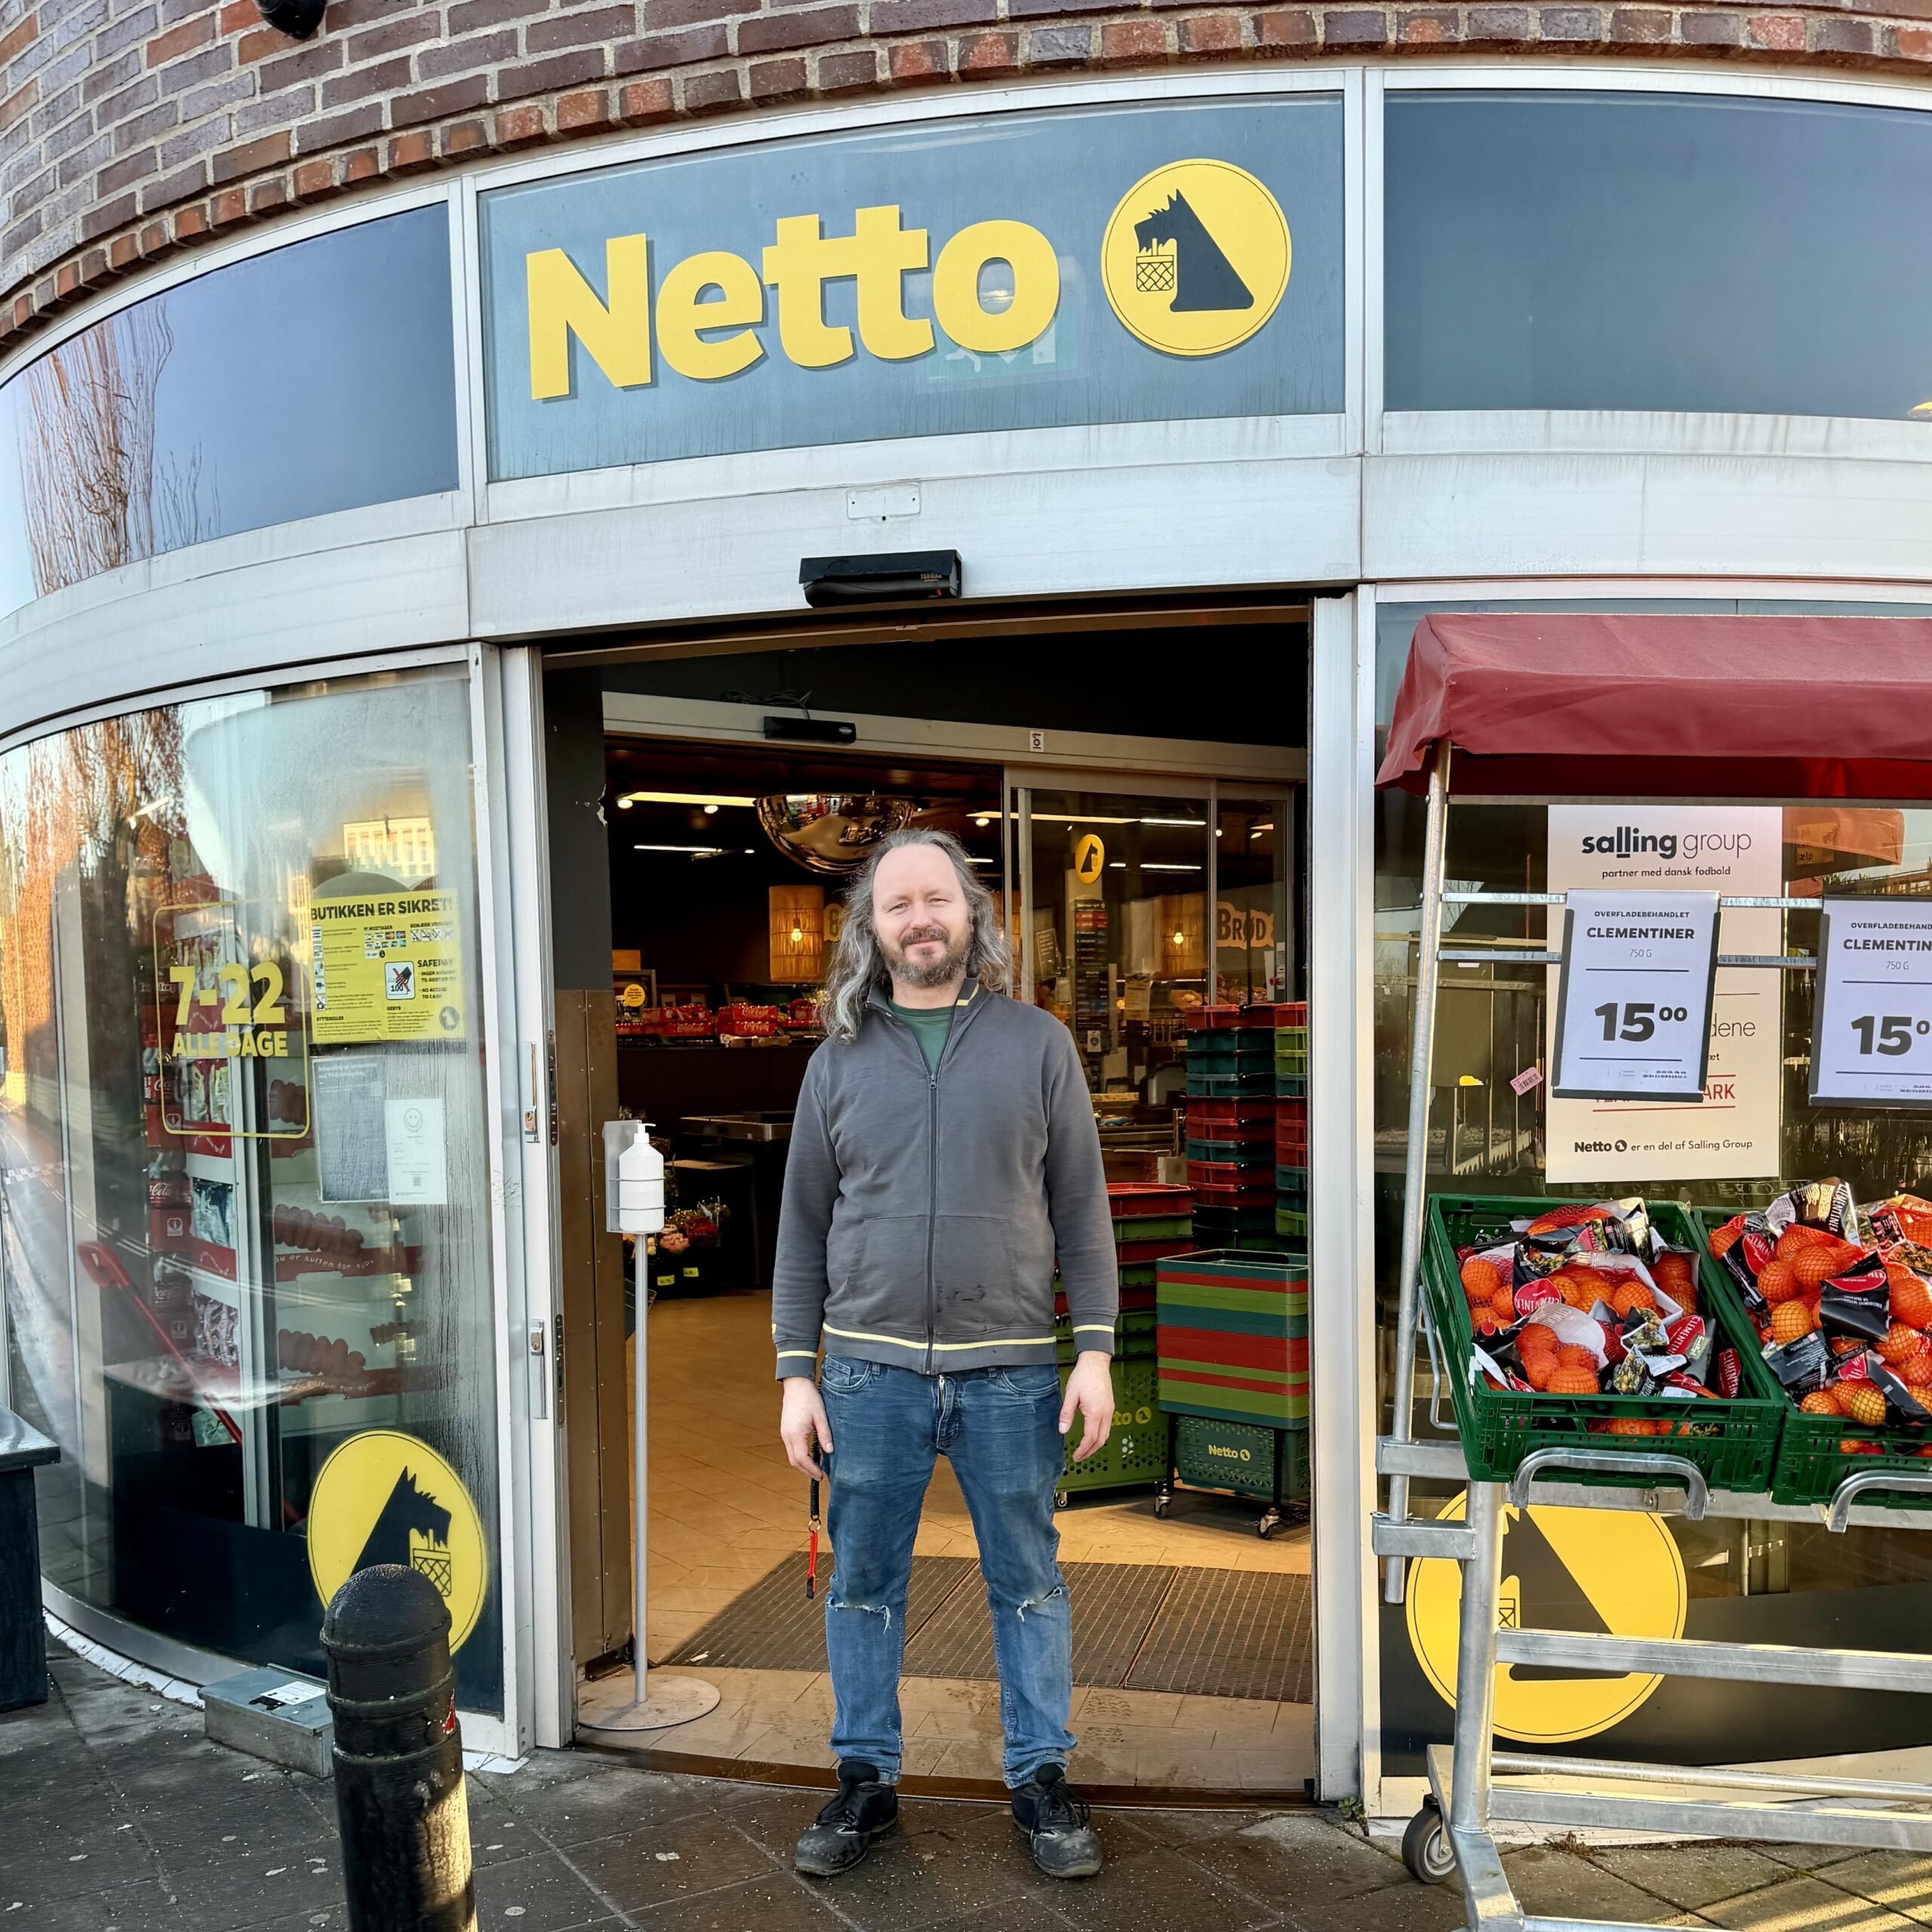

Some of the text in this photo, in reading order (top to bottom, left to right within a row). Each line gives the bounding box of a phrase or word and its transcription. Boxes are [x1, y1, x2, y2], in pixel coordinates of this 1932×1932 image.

[527, 205, 1060, 401] Netto
[1582, 826, 1752, 859] salling group
[1602, 866, 1731, 880] partner med dansk fodbold
[311, 903, 375, 921] BUTIKKEN
[378, 902, 396, 915] ER
[1594, 910, 1690, 918] OVERFLADEBEHANDLET
[1586, 927, 1695, 940] CLEMENTINER
[1843, 939, 1932, 951] CLEMENTIN
[1629, 949, 1653, 958] 750 G
[1887, 961, 1909, 970] 750 G
[170, 961, 285, 1026] 7-22
[172, 1031, 288, 1057] ALLE DAGE
[1574, 1140, 1612, 1152] Netto
[1658, 1141, 1672, 1150] del
[1675, 1141, 1685, 1150] af
[1688, 1140, 1720, 1151] Salling
[1723, 1140, 1753, 1150] Group
[1208, 1444, 1238, 1459] Netto
